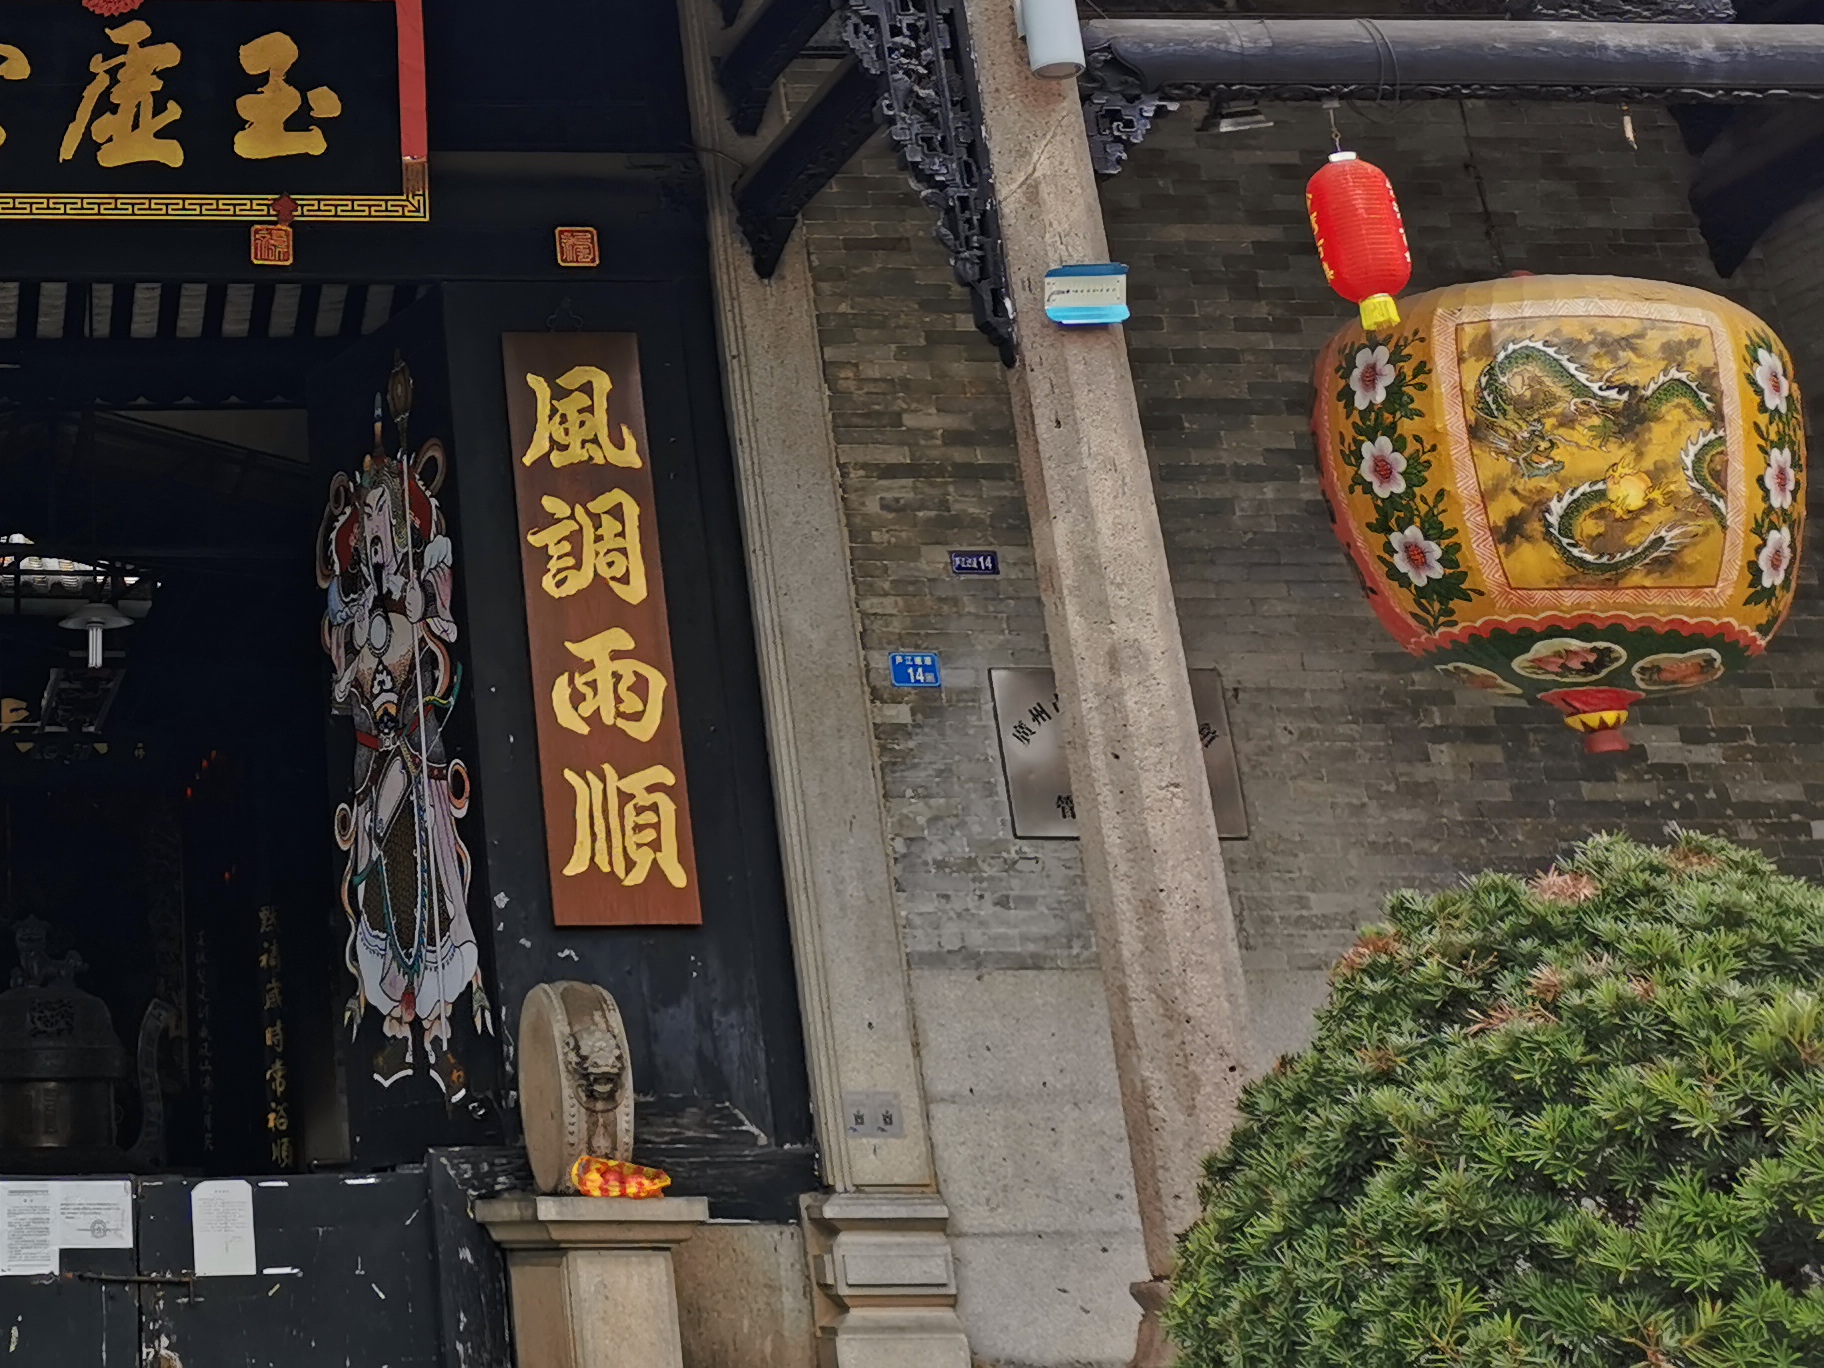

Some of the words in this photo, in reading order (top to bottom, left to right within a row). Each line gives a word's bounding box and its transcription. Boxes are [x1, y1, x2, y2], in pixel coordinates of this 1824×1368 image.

[978, 555, 993, 570] 14
[521, 365, 687, 889] 風調雨順
[906, 666, 925, 683] 14
